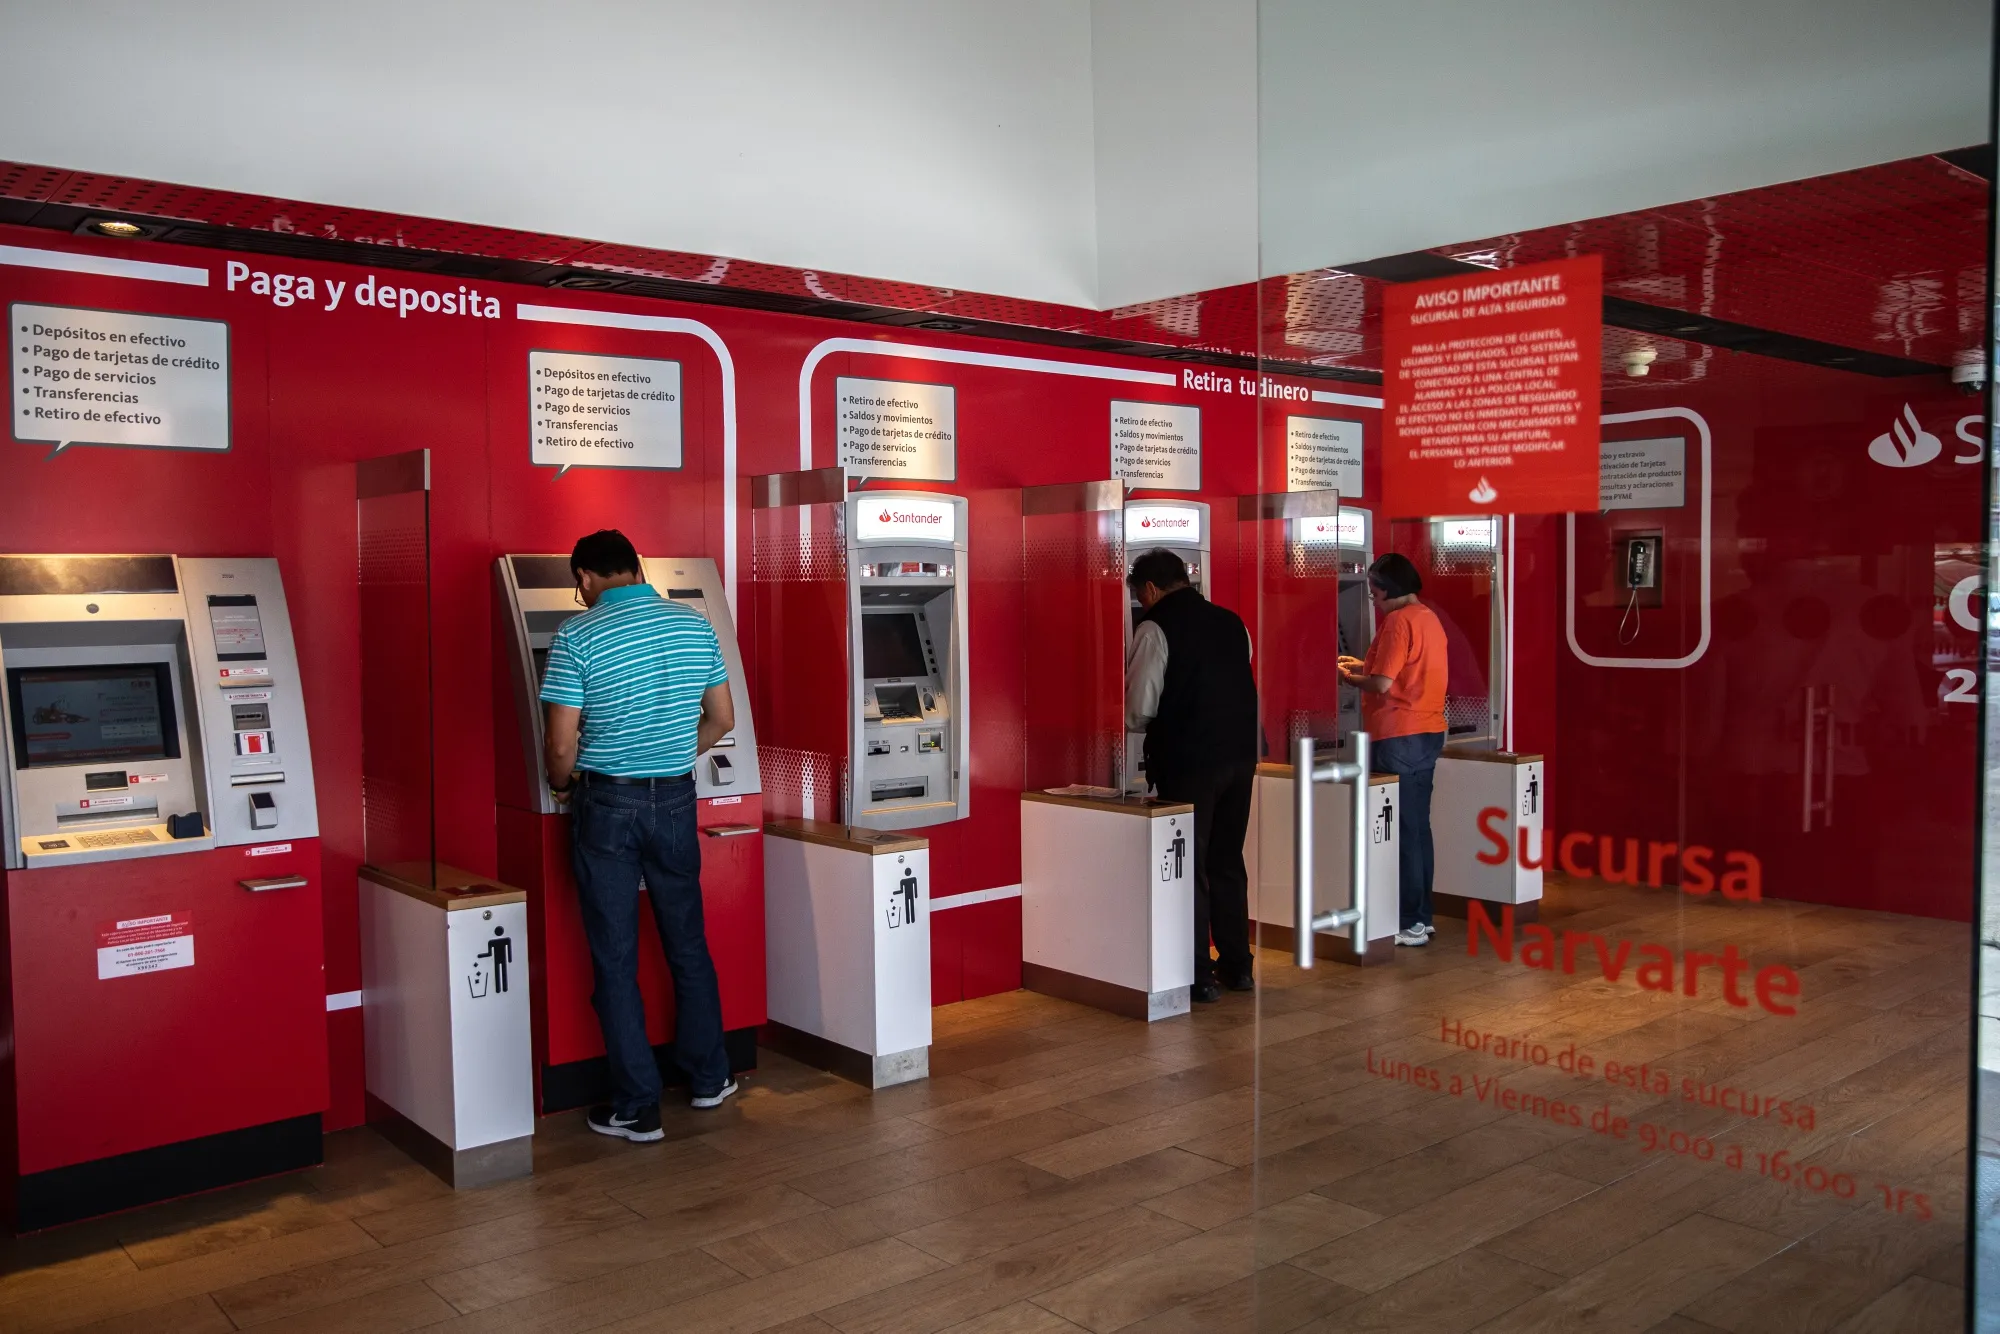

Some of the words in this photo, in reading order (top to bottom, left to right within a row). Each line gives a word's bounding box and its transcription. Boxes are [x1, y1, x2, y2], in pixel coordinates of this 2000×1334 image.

[226, 260, 316, 308] Paga
[324, 280, 346, 310] y
[355, 275, 500, 319] deposita
[1415, 289, 1459, 309] AVISO
[1463, 275, 1561, 302] IMPORTANTE
[1411, 309, 1459, 325] SUCURSAL
[1462, 307, 1475, 318] DE
[1478, 304, 1501, 316] ALTA
[1505, 294, 1567, 313] SEGURIDAD
[33, 324, 106, 342] Depósitos
[110, 333, 126, 343] en
[130, 333, 186, 348] efectivo
[33, 345, 69, 361] Pago
[73, 348, 91, 360] de
[94, 351, 149, 365] tarjetas
[152, 354, 168, 366] de
[172, 357, 220, 370] crédito
[34, 366, 70, 381] Pago
[74, 368, 91, 380] de
[95, 372, 156, 385] servicios
[544, 368, 595, 380] Depósitos
[598, 373, 609, 381] en
[612, 372, 651, 383] efectivo
[1415, 377, 1471, 389] CONECTADOS
[1483, 373, 1501, 382] UNA
[1504, 369, 1544, 380] CENTRAL
[1547, 367, 1559, 376] DE
[1183, 368, 1232, 393] Retira
[1239, 377, 1256, 395] tu
[1260, 377, 1309, 401] dinero
[34, 386, 139, 404] Transferencias
[545, 385, 570, 398] Pago
[572, 387, 584, 396] de
[587, 388, 625, 400] tarjetas
[627, 390, 638, 399] de
[641, 391, 675, 401] crédito
[545, 402, 570, 415] Pago
[573, 403, 585, 413] de
[588, 405, 630, 415] servicios
[849, 396, 874, 406] Retiro
[876, 397, 886, 406] de
[887, 398, 918, 409] efectivo
[35, 407, 80, 420] Retiro
[84, 409, 100, 422] de
[105, 410, 161, 425] efectivo
[849, 411, 875, 421] Saldos
[877, 414, 882, 423] y
[883, 414, 933, 424] movimientos
[1120, 417, 1138, 425] Retiro
[1140, 418, 1147, 426] de
[1149, 419, 1172, 427] efectivo
[545, 419, 618, 431] Transferencias
[850, 426, 869, 437] Pago
[871, 427, 880, 436] de
[883, 428, 912, 439] tarjetas
[914, 430, 923, 438] de
[925, 430, 951, 440] crédito
[1120, 430, 1139, 438] Saldos
[1146, 432, 1183, 441] movimientos
[1295, 431, 1311, 439] Retiro
[1320, 433, 1339, 441] efectivo
[546, 437, 577, 446] Retiro
[580, 438, 591, 447] de
[594, 438, 634, 449] efectivo
[850, 441, 869, 452] Pago
[871, 442, 880, 450] de
[883, 443, 916, 453] servicios
[1120, 443, 1135, 453] Pago
[1145, 445, 1167, 454] tarjetas
[1177, 447, 1197, 455] crédito
[1317, 445, 1348, 453] movimientos
[850, 456, 906, 467] Transferencias
[1120, 456, 1135, 466] Pago
[1145, 458, 1171, 466] servicios
[1295, 455, 1308, 463] Pago
[1316, 456, 1335, 465] tarjetas
[1600, 462, 1629, 470] ctivación
[1120, 470, 1163, 478] Transferencias
[1295, 467, 1308, 475] Pago
[1600, 472, 1637, 480] ontratación
[1648, 470, 1681, 478] productos
[1295, 479, 1332, 487] Transferencias
[893, 512, 942, 524] Santander
[1152, 518, 1189, 528] Santander
[1476, 806, 1762, 902] Sucursa
[1466, 899, 1801, 1017] Narvarte
[1440, 1016, 1549, 1067] Horario
[1558, 1044, 1595, 1080] de
[1604, 1058, 1671, 1096] esta
[1366, 1047, 1442, 1092] Lunes
[1449, 1073, 1463, 1097] a
[1472, 1074, 1582, 1129] Viernes
[1591, 1104, 1630, 1139] de
[1638, 1122, 1716, 1161] 9:00
[1725, 1144, 1743, 1171] a
[1756, 1150, 1857, 1199] 16:00
